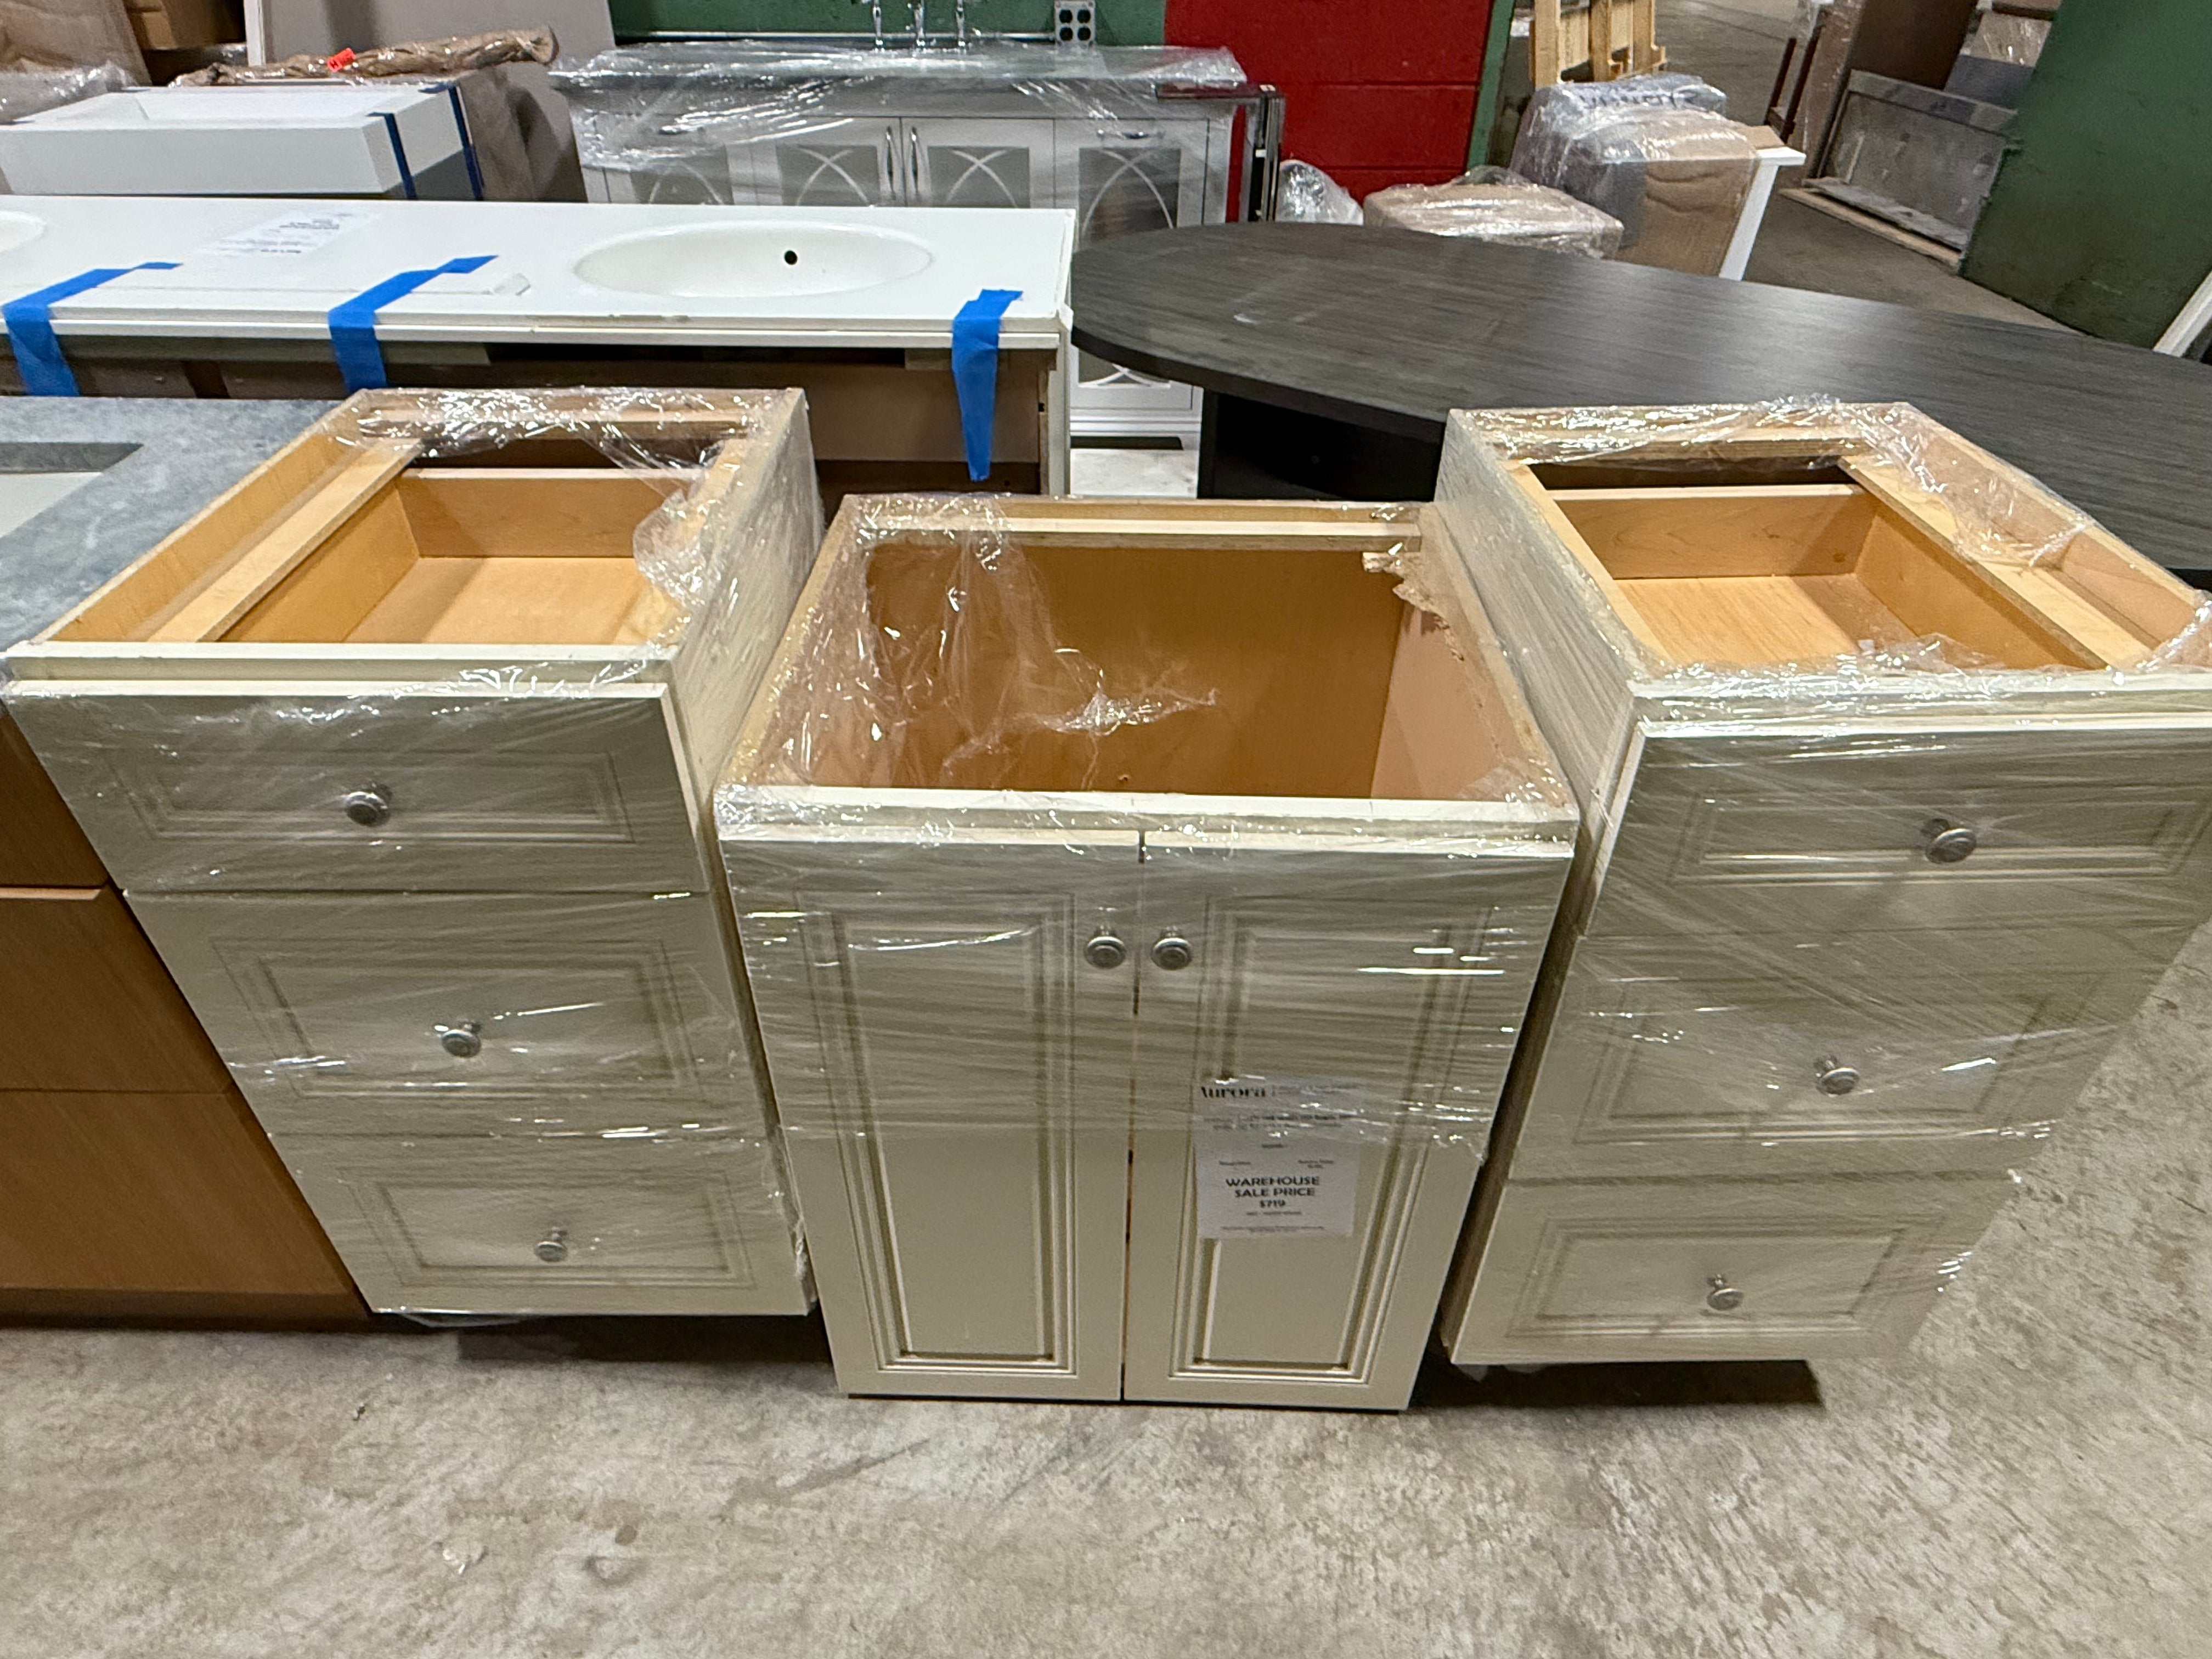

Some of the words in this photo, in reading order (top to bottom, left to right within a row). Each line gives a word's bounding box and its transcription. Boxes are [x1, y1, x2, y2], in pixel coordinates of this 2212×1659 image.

[1226, 1176, 1319, 1187] WAREHOUSE
[1235, 1188, 1268, 1198] SALE
[1273, 1187, 1315, 1197] PRICE
[1260, 1199, 1286, 1209] $719
